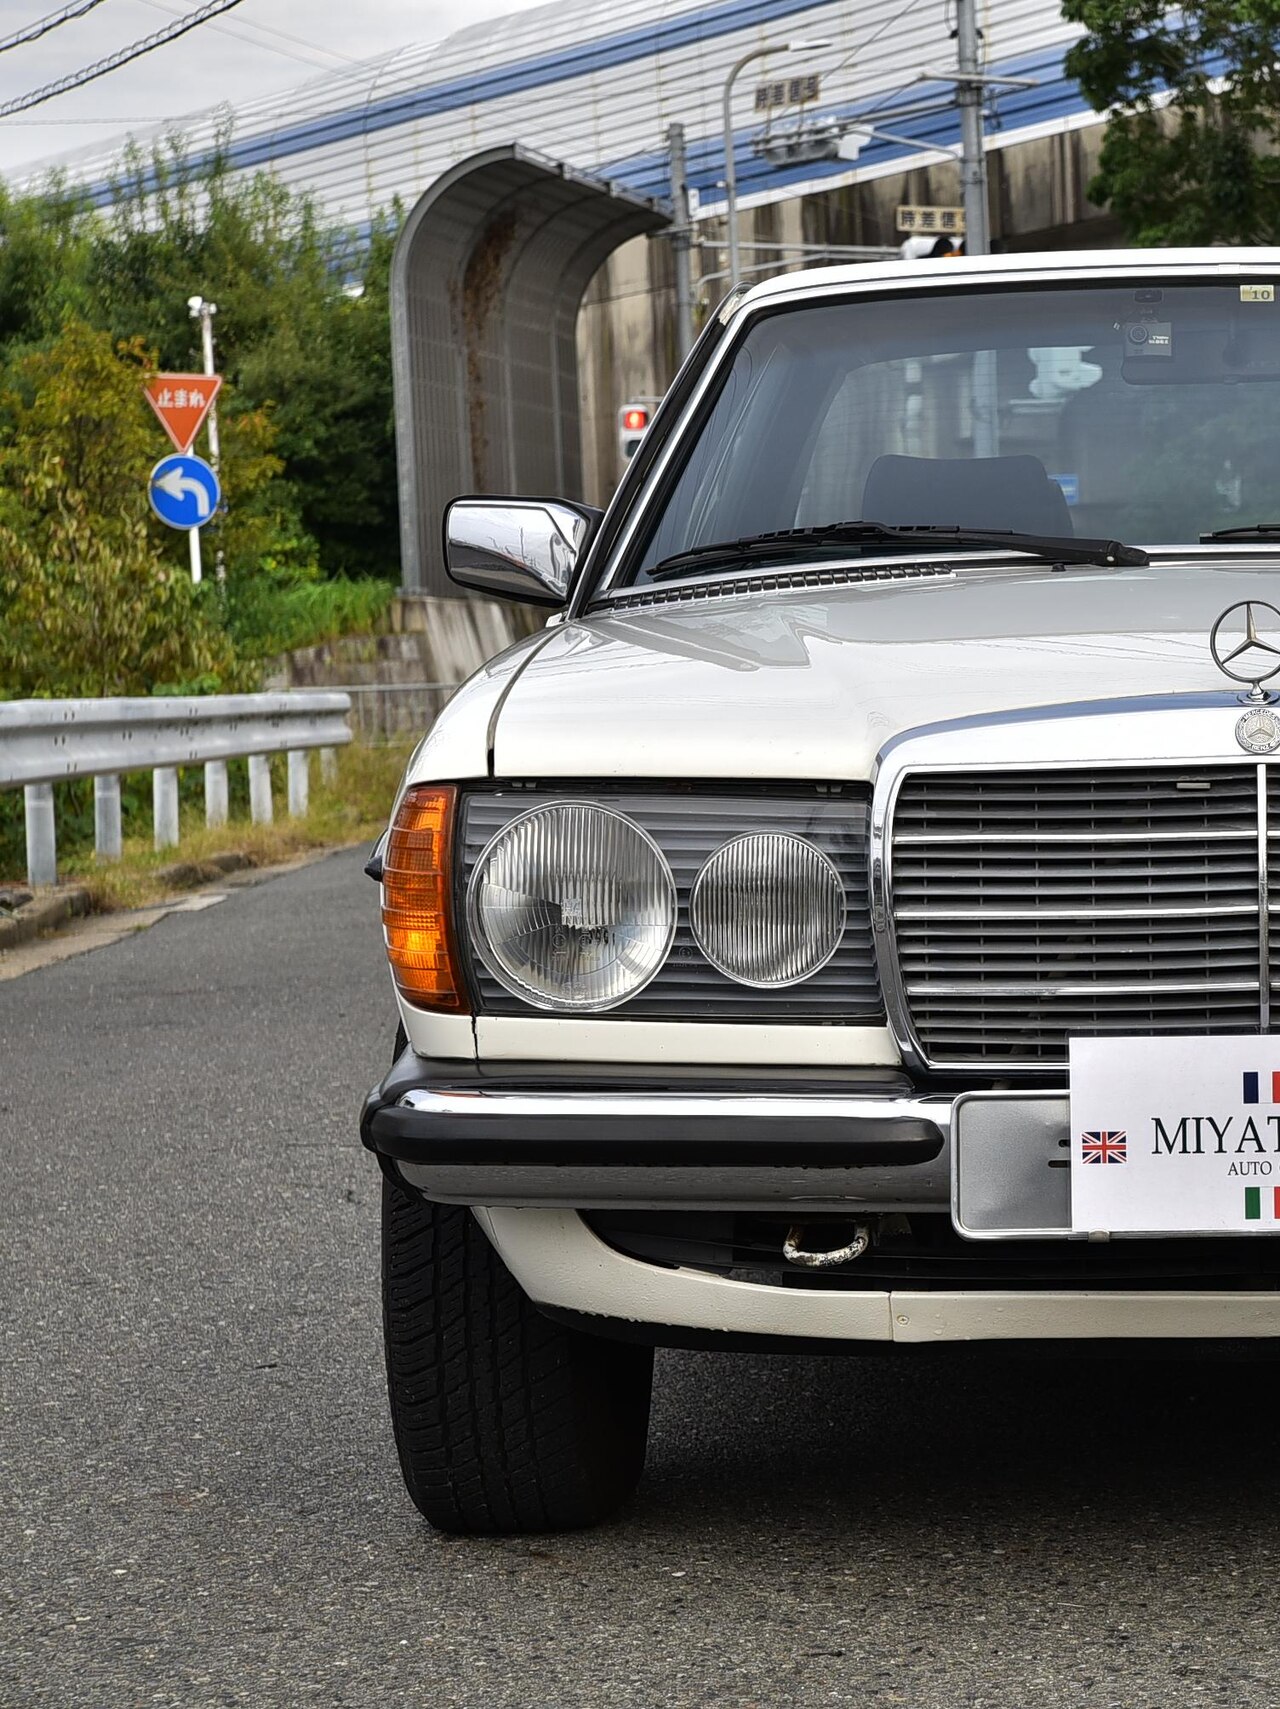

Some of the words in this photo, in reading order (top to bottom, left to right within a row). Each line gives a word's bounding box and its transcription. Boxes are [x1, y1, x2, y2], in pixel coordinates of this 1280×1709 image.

[901, 210, 965, 229] 時差信
[157, 387, 205, 408] 止まれ
[1228, 1161, 1272, 1176] AUTO
